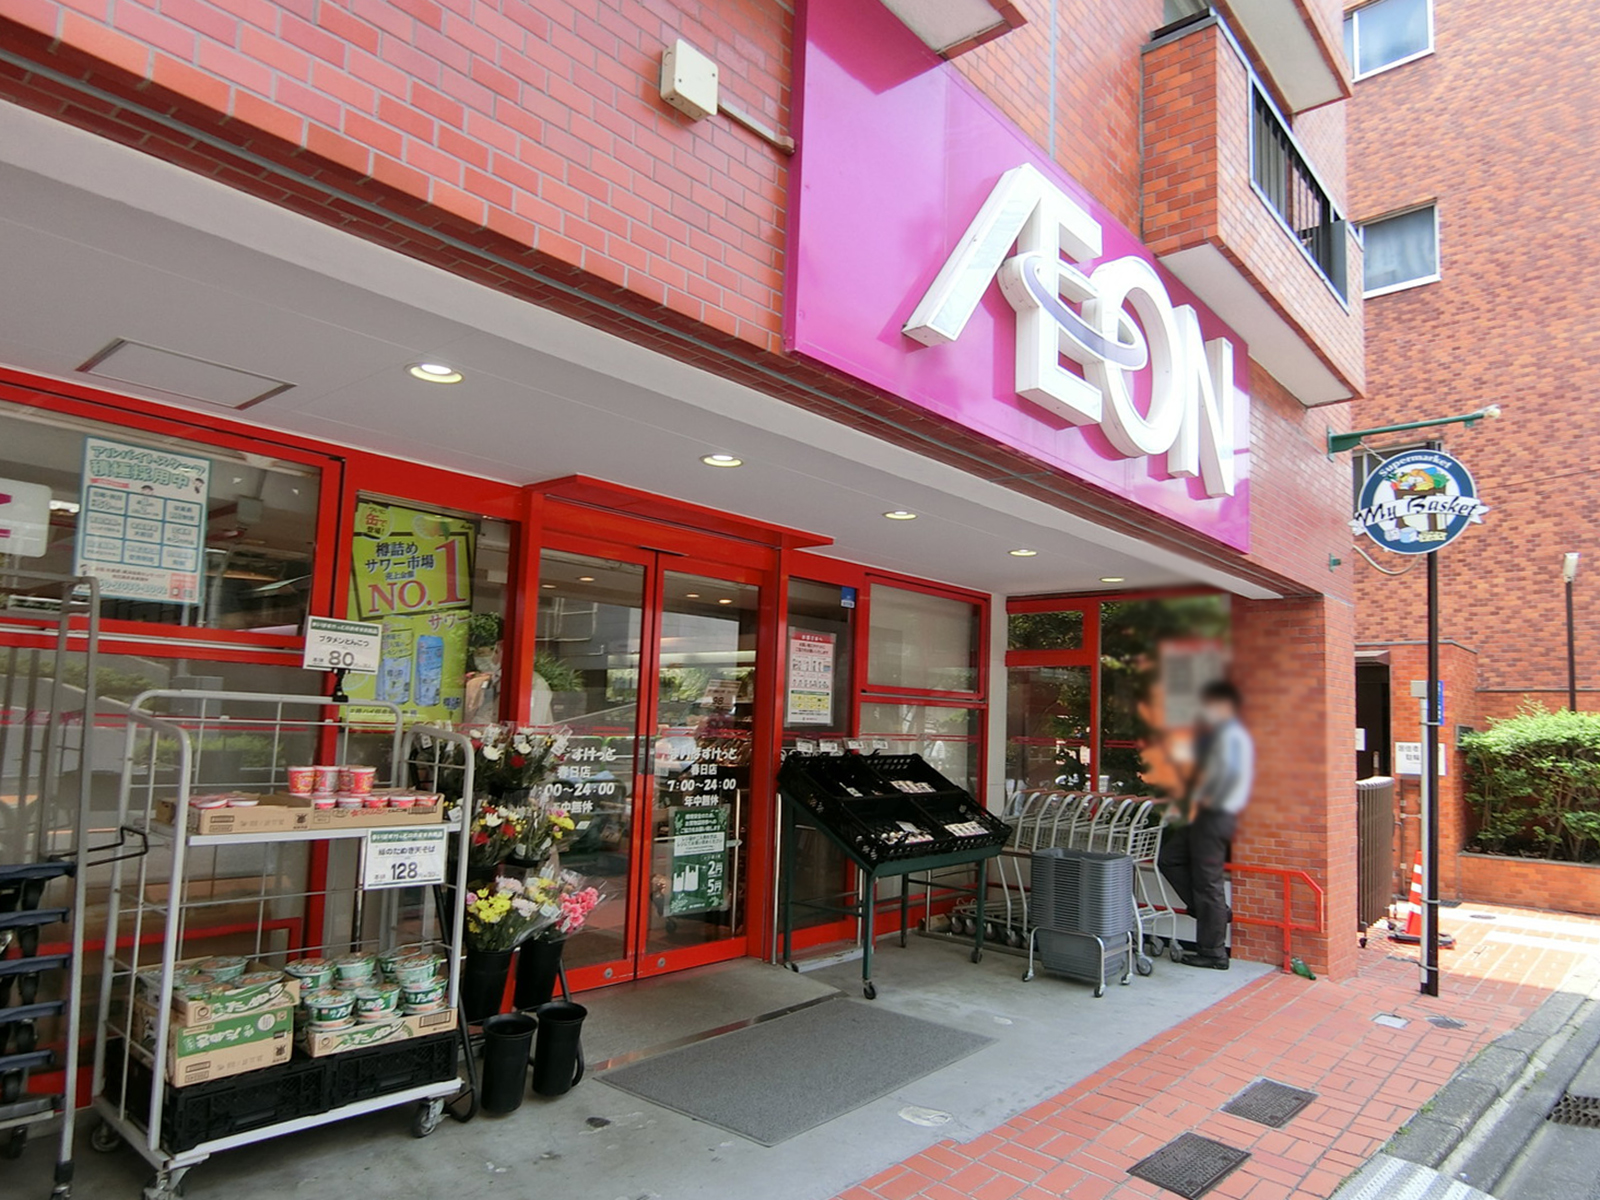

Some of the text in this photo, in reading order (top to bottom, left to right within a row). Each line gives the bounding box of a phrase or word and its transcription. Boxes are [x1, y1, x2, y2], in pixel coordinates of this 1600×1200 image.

[1379, 454, 1453, 477] Supermarket
[1355, 494, 1478, 525] My Basket
[365, 513, 388, 527] 缶で
[376, 541, 418, 558] 樽詰め
[365, 554, 435, 575] サワー市場
[428, 612, 472, 632] サワー
[318, 635, 370, 647] ブタメンとんこつ
[328, 650, 354, 667] 80
[557, 766, 592, 779] 春日店
[691, 763, 718, 776] 春日店
[684, 794, 719, 807] 年中無休
[378, 845, 436, 856] 緑のたぬき天そば
[391, 862, 418, 881] 128
[707, 860, 724, 876] 2円
[707, 879, 722, 894] 5円
